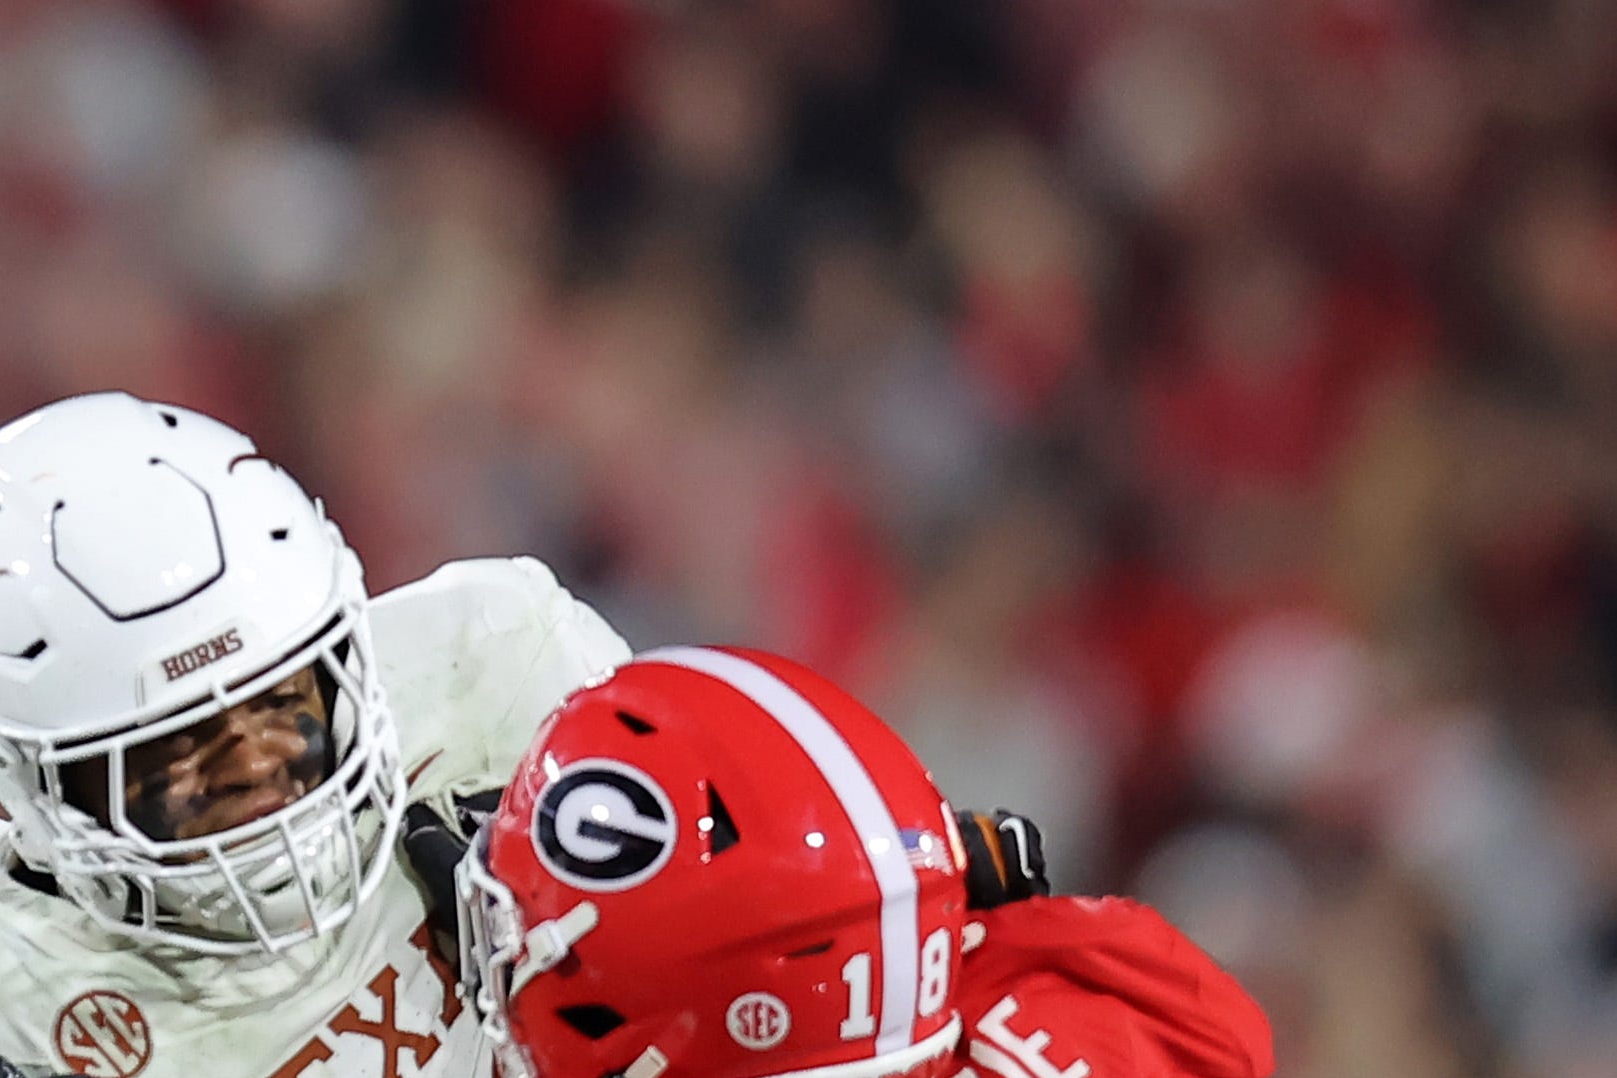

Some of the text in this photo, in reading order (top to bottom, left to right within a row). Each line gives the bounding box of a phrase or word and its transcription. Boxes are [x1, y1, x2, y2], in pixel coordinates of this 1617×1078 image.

[160, 627, 244, 682] HORNS
[536, 768, 670, 882] G
[734, 999, 782, 1042] SEC
[840, 927, 951, 1040] 18
[59, 993, 148, 1078] SEC
